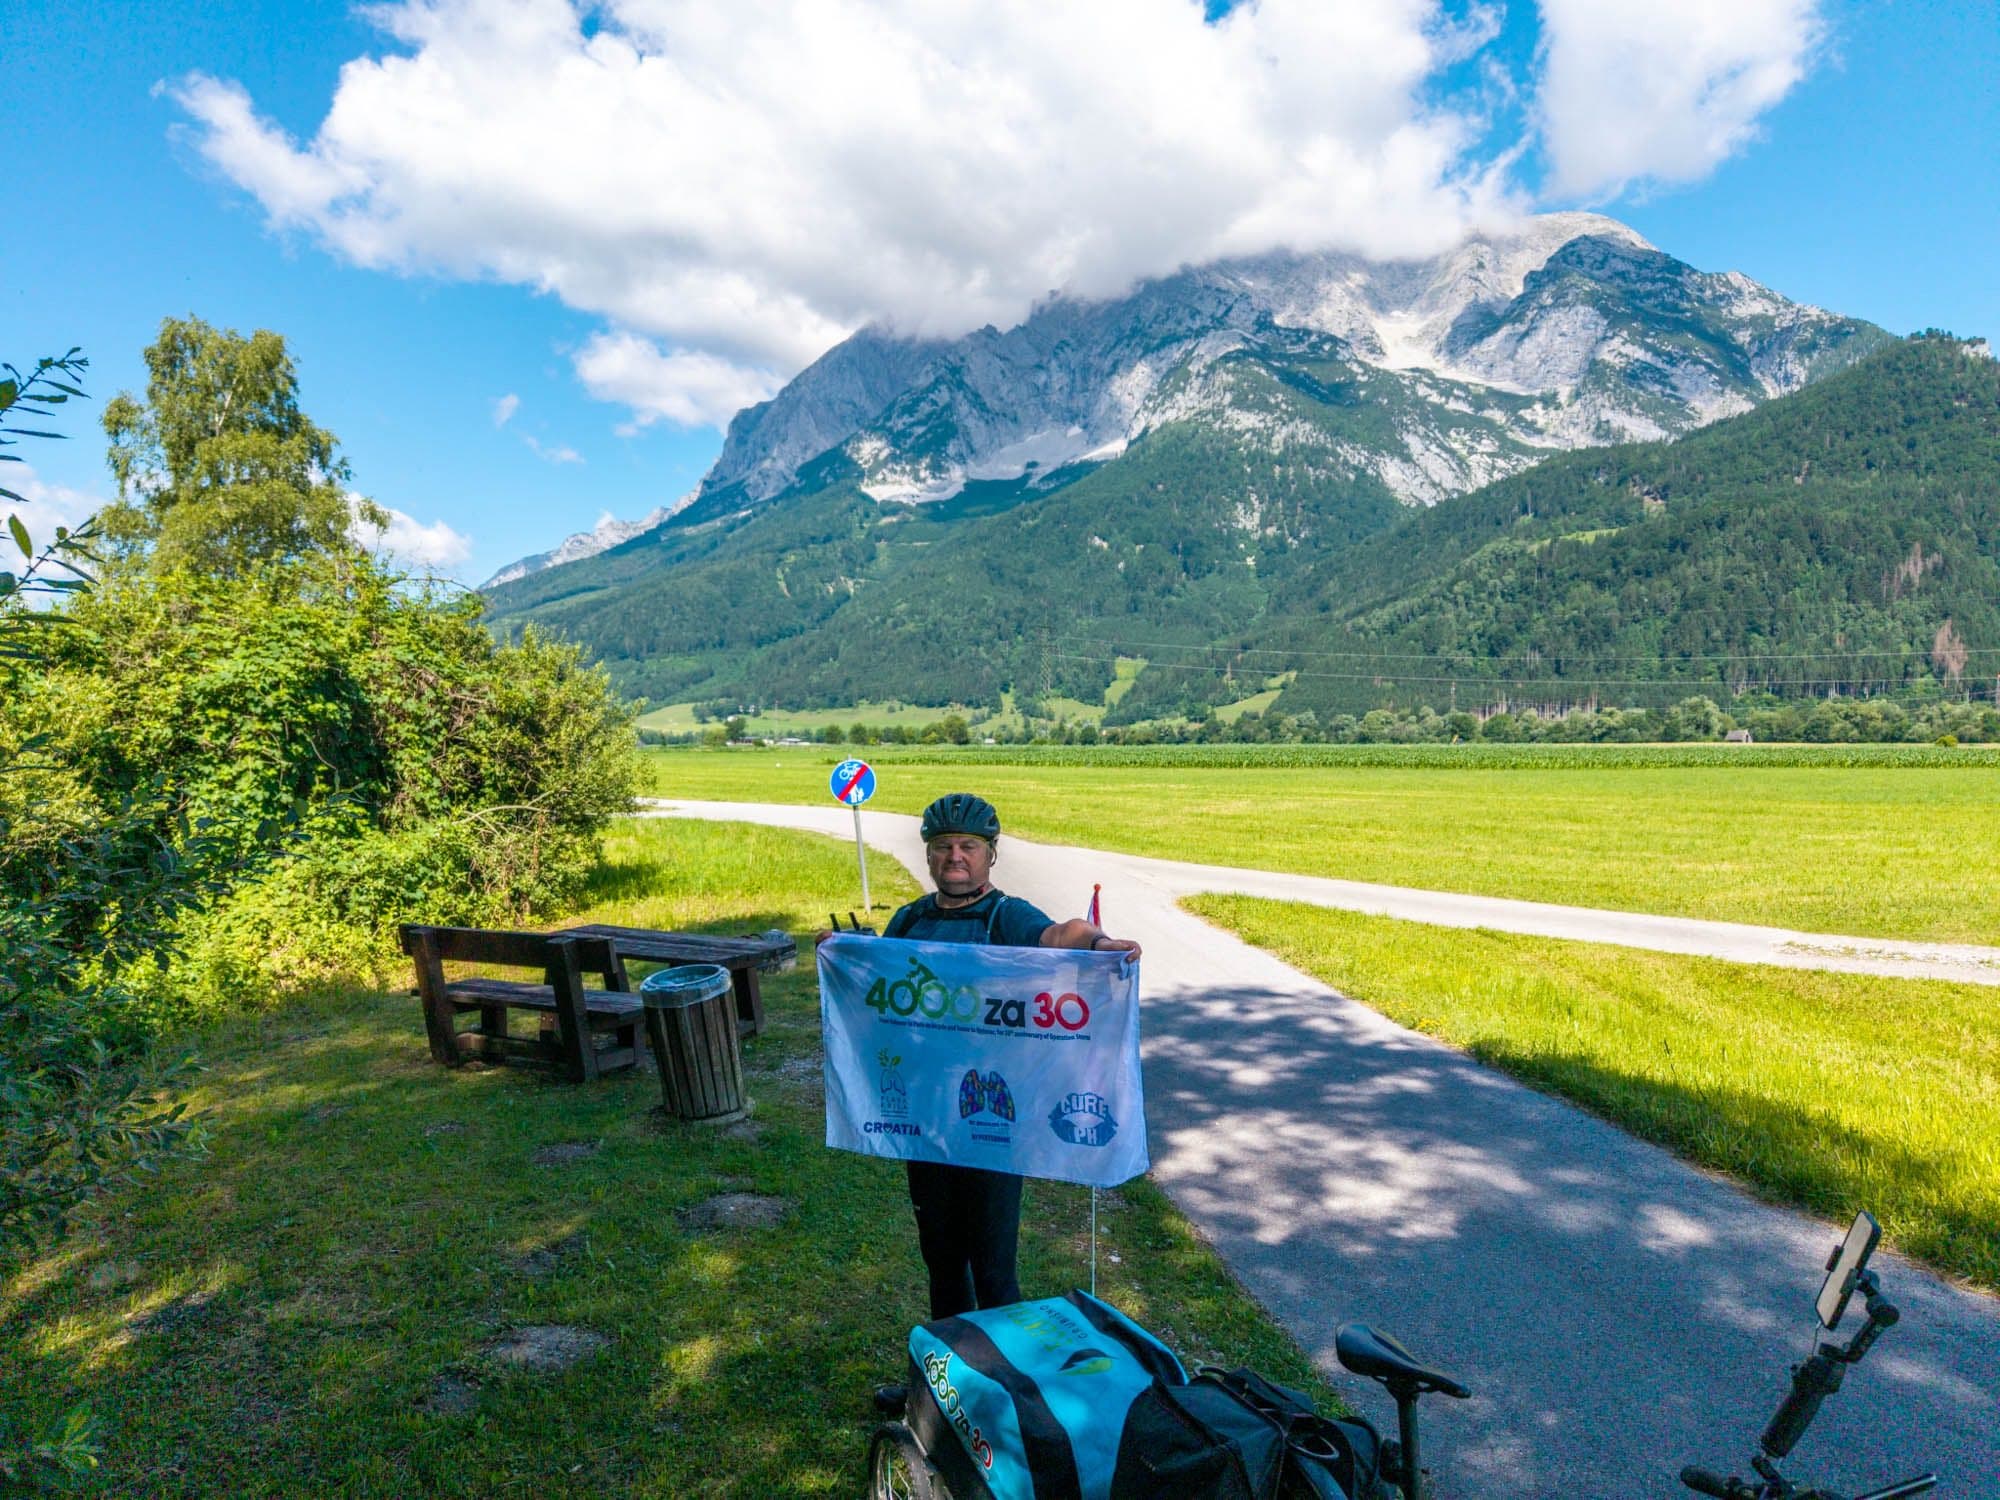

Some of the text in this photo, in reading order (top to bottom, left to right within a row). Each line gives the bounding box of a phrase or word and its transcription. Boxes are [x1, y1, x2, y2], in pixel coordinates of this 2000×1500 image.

[865, 976, 1091, 1031] 4000 za 30
[1061, 1094, 1108, 1117] CURE
[954, 1408, 971, 1436] za
[972, 1427, 993, 1469] 30
